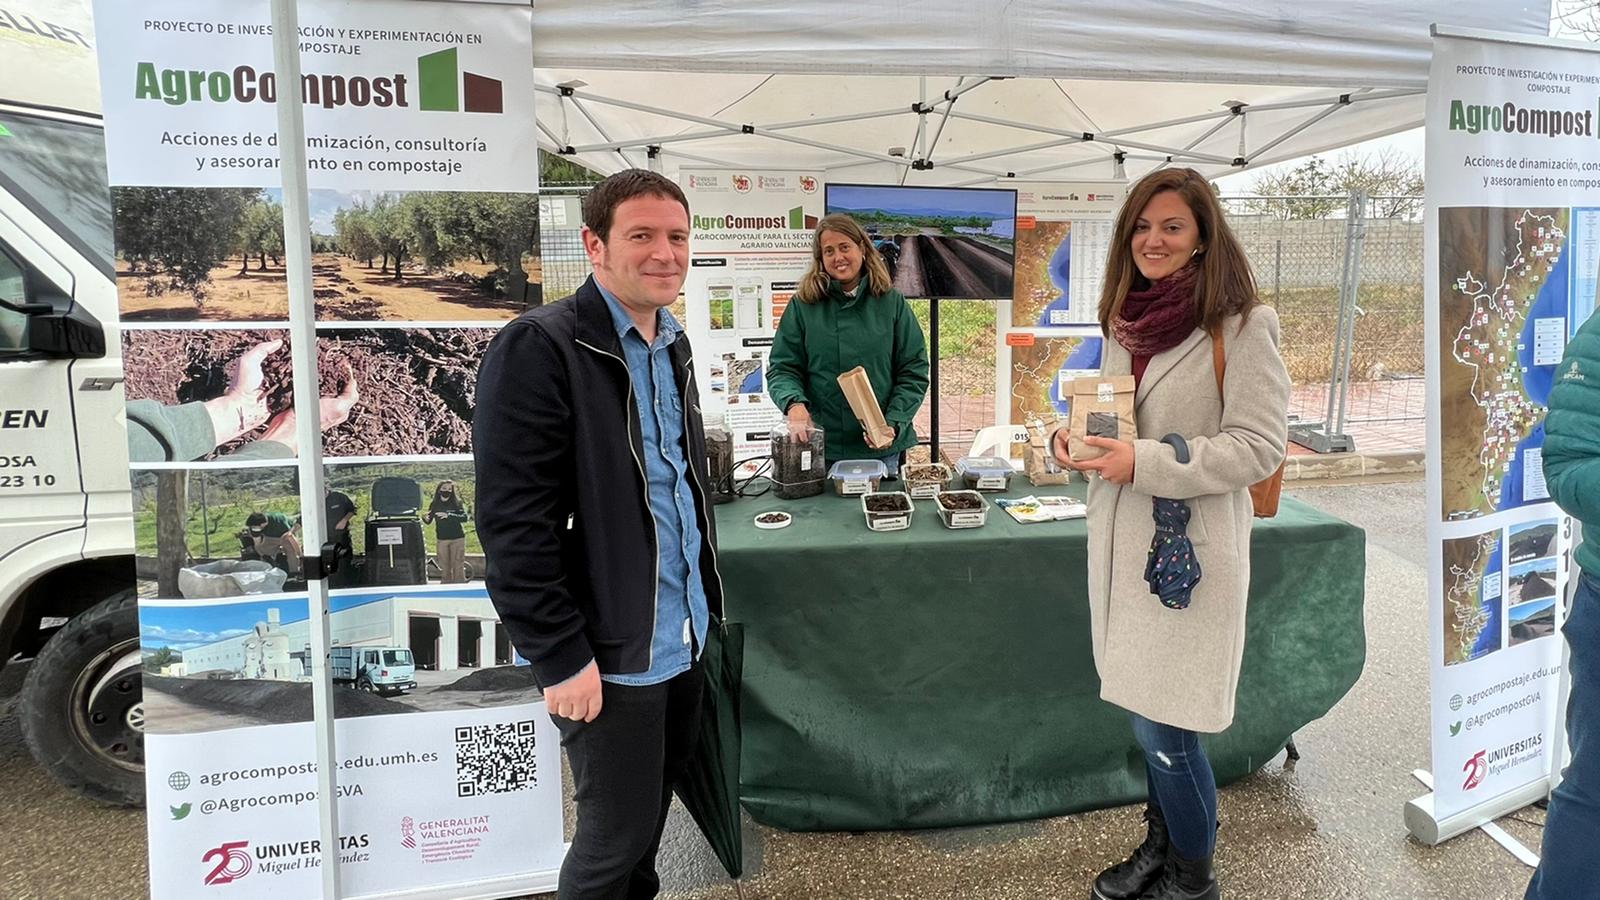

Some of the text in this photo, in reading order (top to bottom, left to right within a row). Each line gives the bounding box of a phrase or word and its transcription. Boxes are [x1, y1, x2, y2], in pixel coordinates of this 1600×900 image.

[144, 20, 482, 44] PROYECTO DE INVESACIÓN Y EXPERIMENTACIÓN EN
[1456, 65, 1600, 84] PROYECTO DE INVESTIGACIÓN Y EXPERIMEN
[136, 61, 409, 109] AgroCompost
[1527, 83, 1571, 94] COMPOSTAJE
[1449, 99, 1592, 137] AgroCompost
[161, 131, 487, 153] Acciones de dmización, consultoría
[196, 157, 463, 175] y asesoranto en compostaje
[1464, 155, 1504, 168] Acciones
[1506, 157, 1517, 169] de
[1519, 157, 1580, 172] dinamización,
[1483, 176, 1489, 188] y
[1490, 174, 1555, 187] asesoramiento
[1557, 177, 1568, 187] en
[693, 214, 786, 230] AgroCompost
[694, 233, 762, 241] AGROCOMPOSTAJE
[792, 232, 815, 240] SECTO
[0, 474, 56, 487] 23 10
[1465, 691, 1541, 731] @AgrocompostGVA
[1488, 733, 1543, 764] UNIVERSITAS
[1488, 760, 1510, 777] Miguel
[419, 815, 490, 831] GENERALITAT
[421, 825, 490, 839] VALENCIANA
[255, 833, 369, 860] UNIVERTAS
[257, 851, 370, 876] Miguel Hendez
